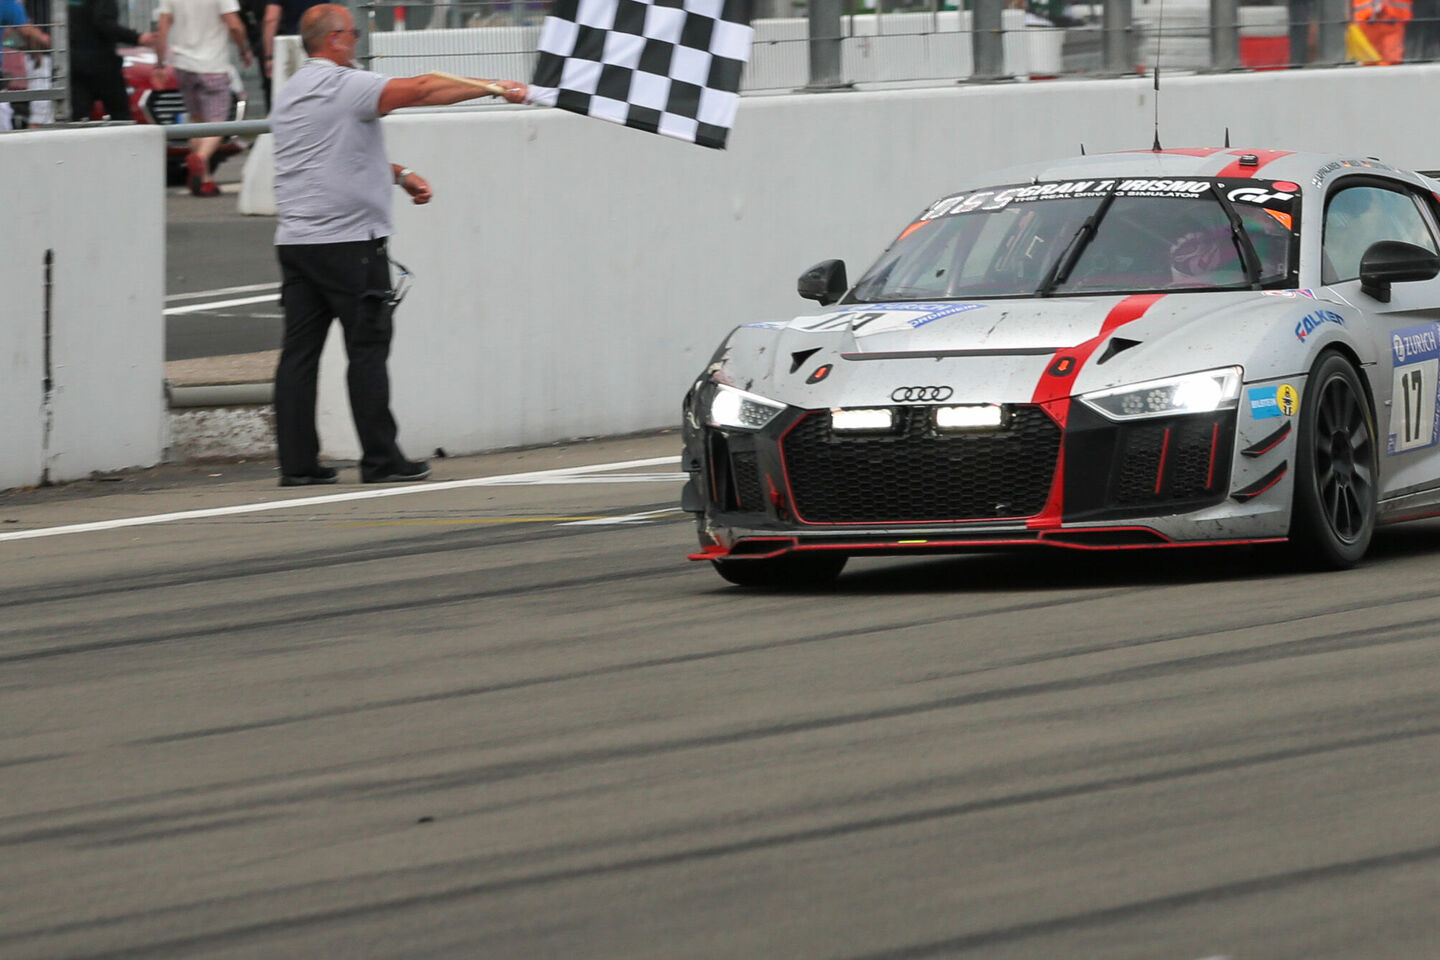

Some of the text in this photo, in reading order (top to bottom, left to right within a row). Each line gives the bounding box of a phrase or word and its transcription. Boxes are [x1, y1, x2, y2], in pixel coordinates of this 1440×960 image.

[1016, 180, 1096, 197] GRAN
[1127, 191, 1200, 199] SIMULATOR
[1295, 309, 1345, 343] FALKEN
[1403, 331, 1438, 357] ZURICH
[1401, 369, 1422, 443] 17
